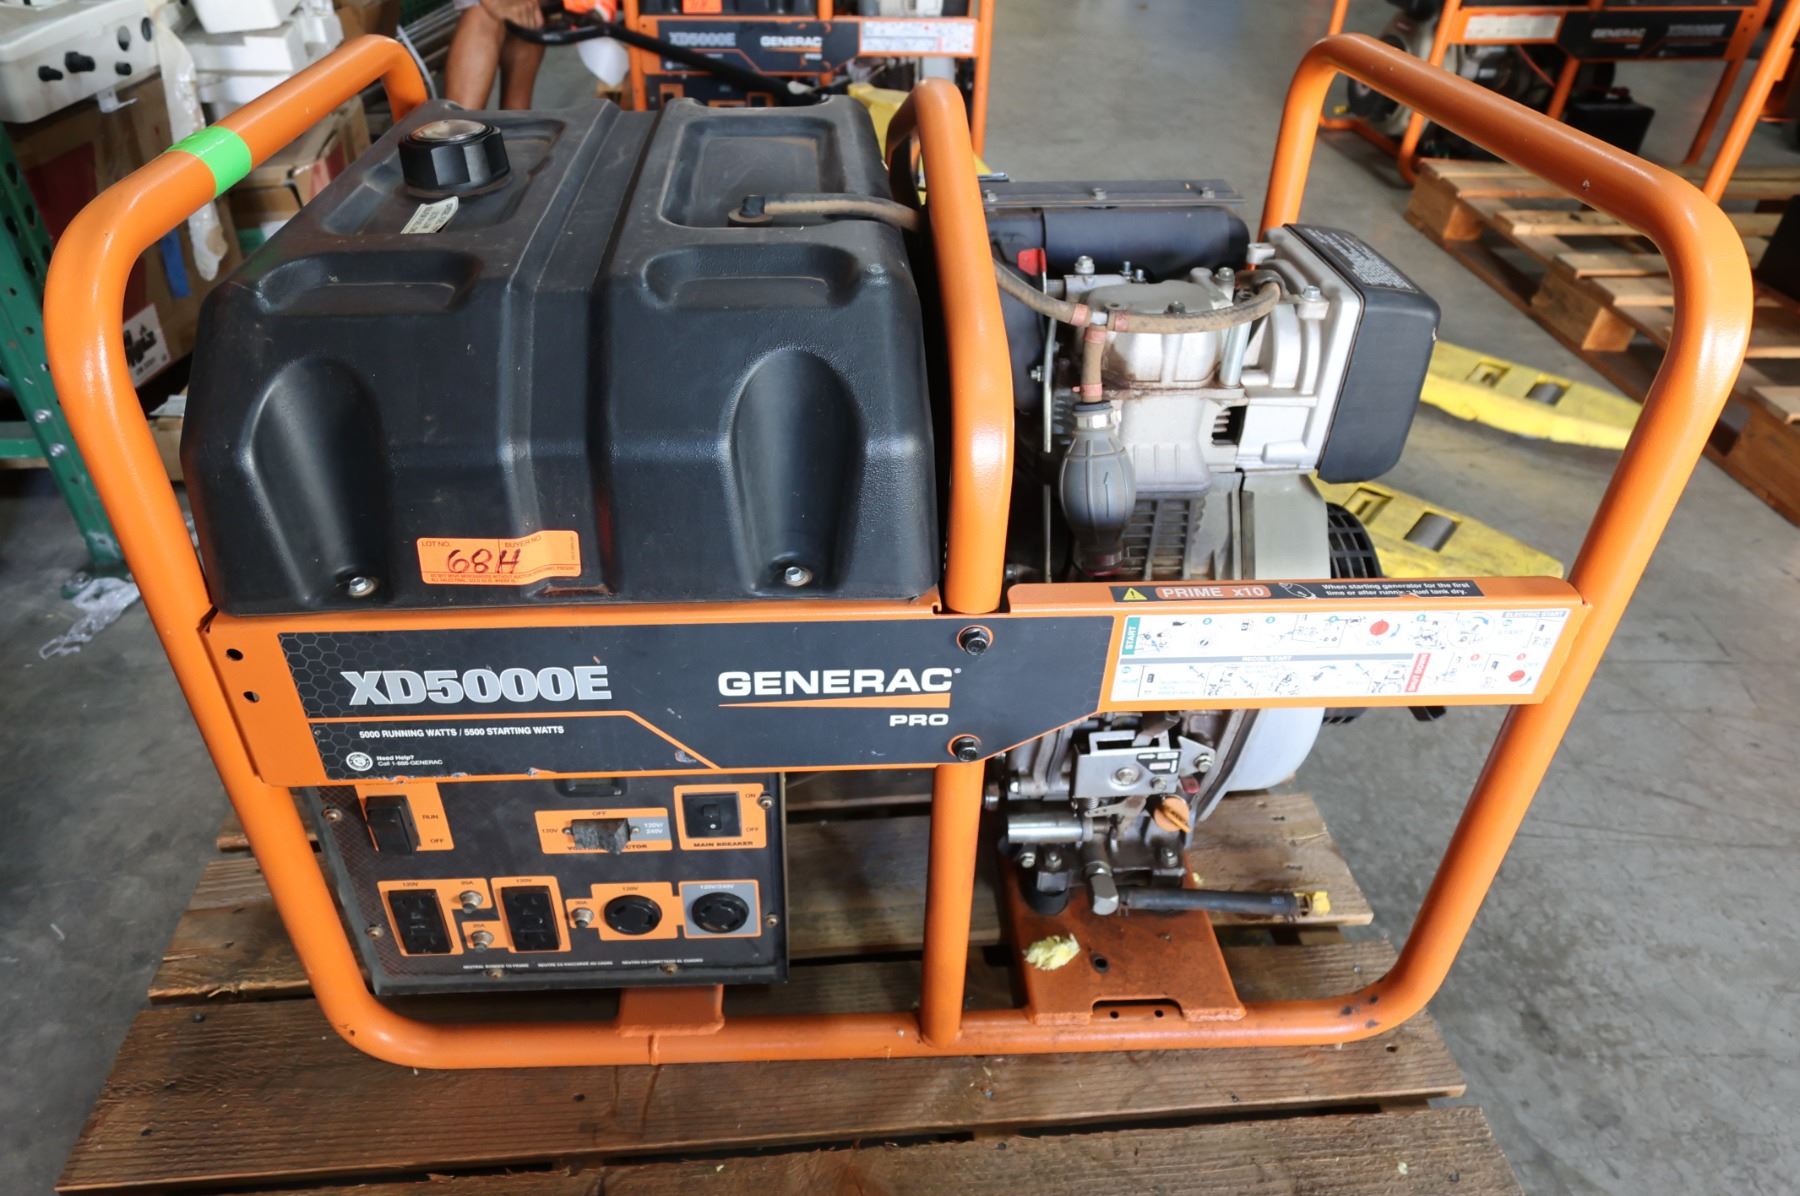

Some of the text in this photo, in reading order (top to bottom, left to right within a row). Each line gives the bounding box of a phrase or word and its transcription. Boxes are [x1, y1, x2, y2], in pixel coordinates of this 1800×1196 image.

[760, 35, 822, 47] GENERAC
[1162, 586, 1264, 598] PRIME x10
[1348, 583, 1380, 591] starting
[1125, 626, 1137, 650] START
[340, 665, 612, 706] XD5000E
[718, 667, 953, 697] GENERAC
[889, 713, 949, 727] PRO
[359, 730, 380, 739] 5000
[382, 728, 425, 738] RUNNING
[425, 728, 458, 737] WATTS
[464, 728, 485, 736] 5500
[486, 726, 532, 736] STARTING
[532, 725, 564, 735] WATTS
